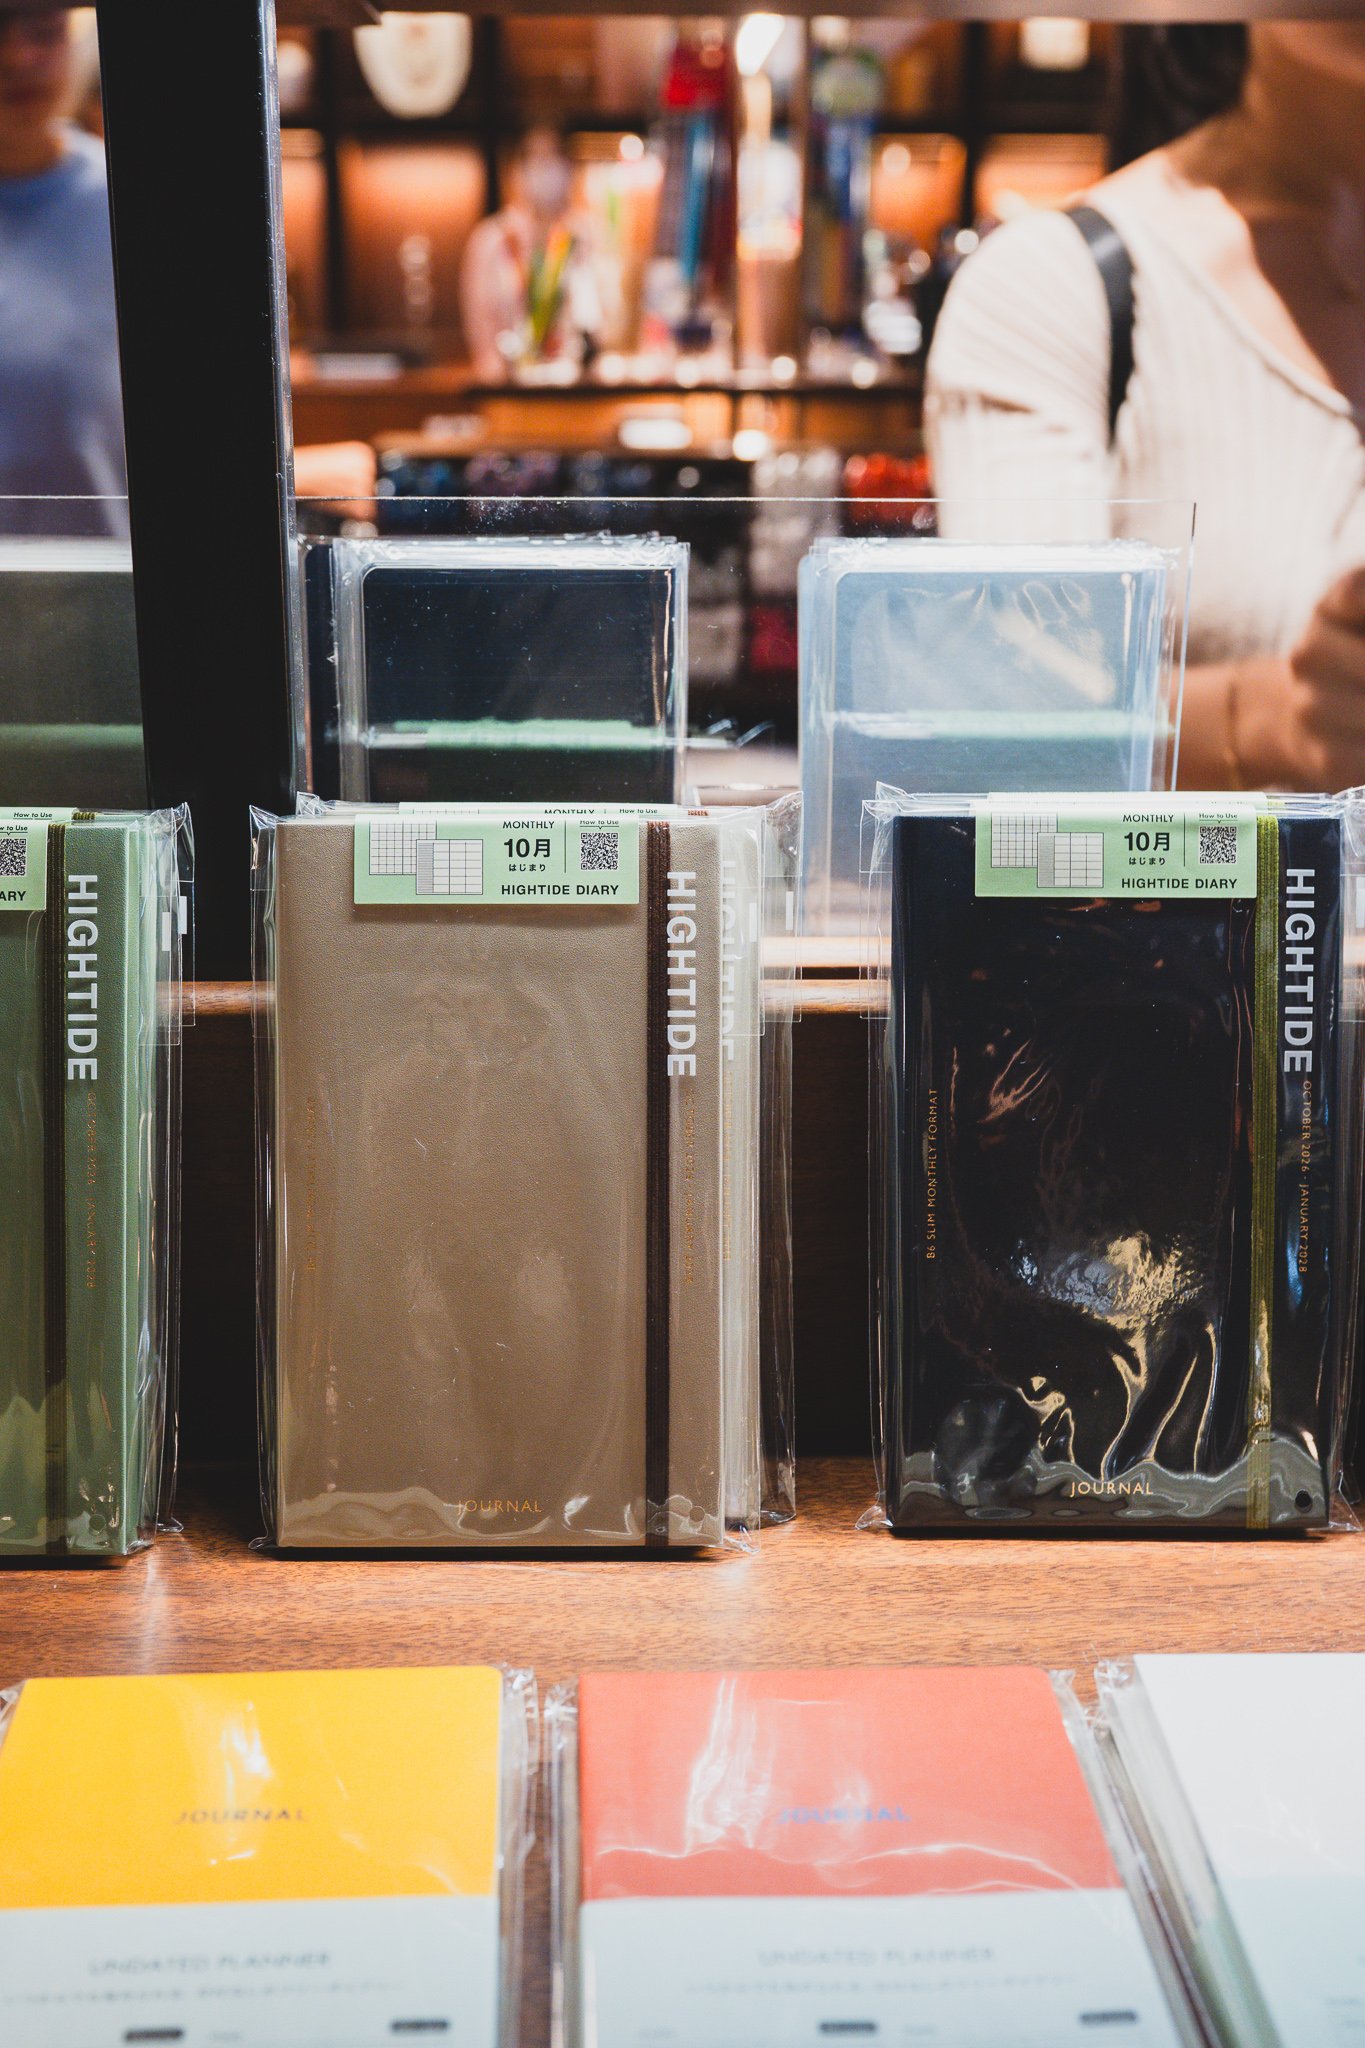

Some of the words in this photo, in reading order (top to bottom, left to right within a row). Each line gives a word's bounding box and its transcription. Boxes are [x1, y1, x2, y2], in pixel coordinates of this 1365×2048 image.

[502, 820, 555, 829] MONTHLY
[1122, 814, 1174, 822] MONTHLY
[504, 838, 550, 858] 10月
[1124, 832, 1170, 852] 10月
[508, 863, 546, 872] はじまり
[1128, 856, 1166, 866] はじまり
[501, 884, 570, 895] HIGHTIDE
[576, 884, 619, 895] DIARY
[1121, 878, 1190, 889] HIGHTIDE
[1195, 878, 1238, 889] DIARY
[67, 875, 98, 1080] HIGHTIDE
[666, 872, 697, 1076] HIGHTIDE
[1284, 868, 1316, 1072] HIGHTIDE
[928, 1089, 938, 1141] FORMAT
[1302, 1080, 1312, 1140] OCTOBER
[1301, 1144, 1311, 1173] 2026
[928, 1146, 938, 1207] MONTHLY
[1299, 1183, 1310, 1240] JANUARY
[927, 1213, 936, 1240] SLIM
[926, 1245, 936, 1259] B6
[1298, 1244, 1308, 1273] 2028
[1069, 1482, 1154, 1498] JOURNAL
[457, 1499, 544, 1514] JOURNAL
[176, 1808, 308, 1824] JOURNAL
